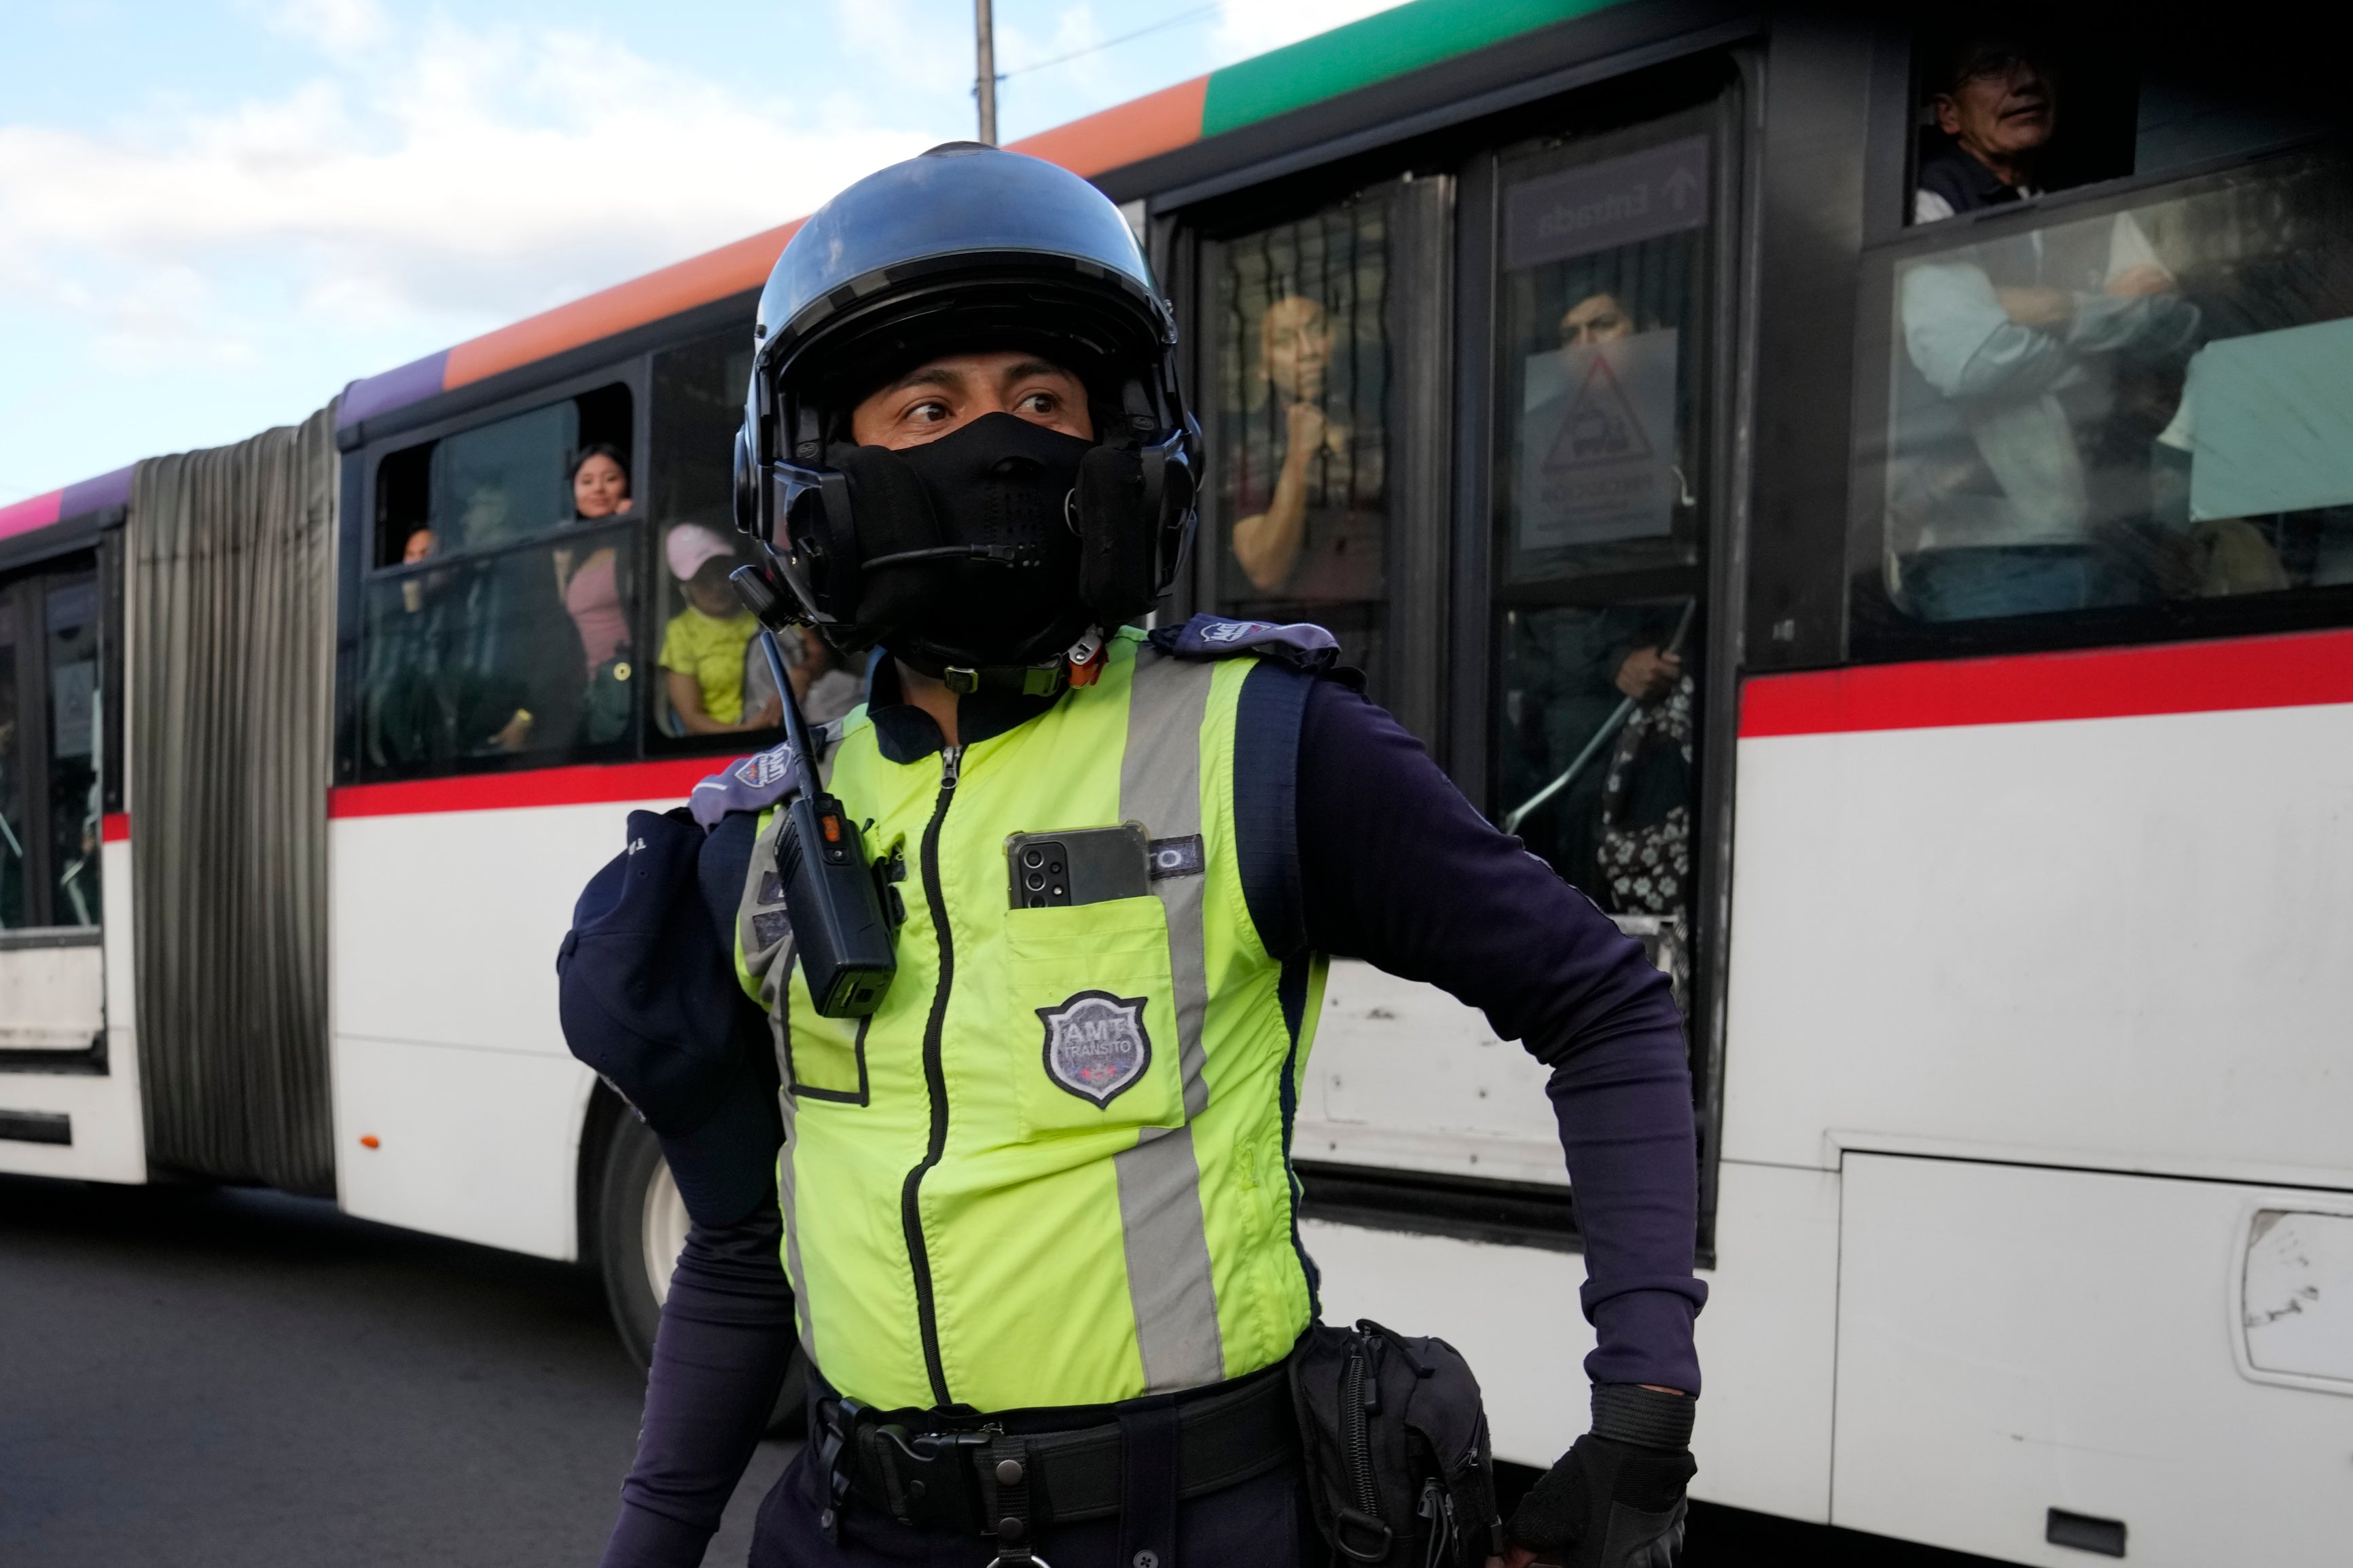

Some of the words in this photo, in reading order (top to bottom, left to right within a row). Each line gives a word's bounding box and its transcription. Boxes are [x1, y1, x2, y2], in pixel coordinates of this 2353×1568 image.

[768, 750, 785, 779] AMT
[1064, 1018, 1127, 1043] AMT
[1064, 1039, 1132, 1059] TRANSITO
